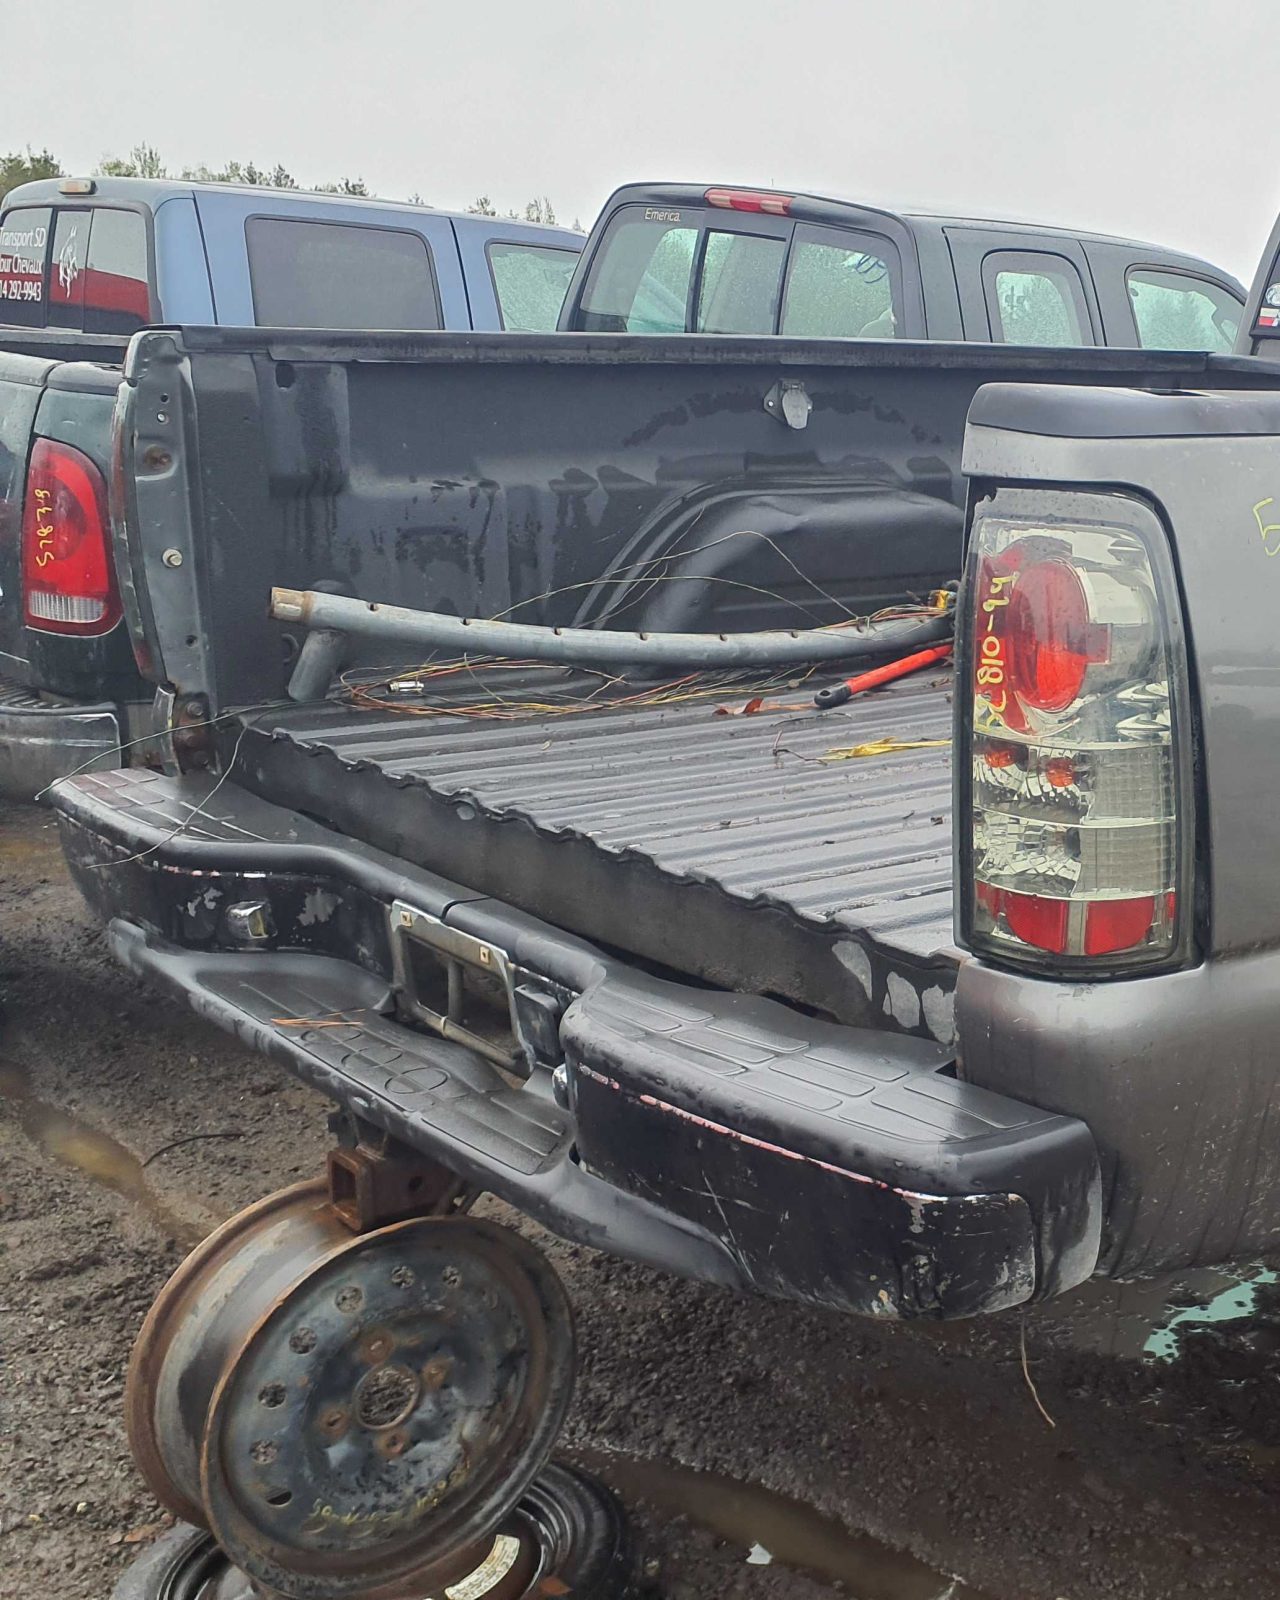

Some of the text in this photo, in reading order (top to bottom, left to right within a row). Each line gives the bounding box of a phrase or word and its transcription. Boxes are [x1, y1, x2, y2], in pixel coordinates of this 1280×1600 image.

[34, 227, 46, 247] SD
[12, 254, 43, 274] Chevaux
[8, 280, 42, 301] 292-9943
